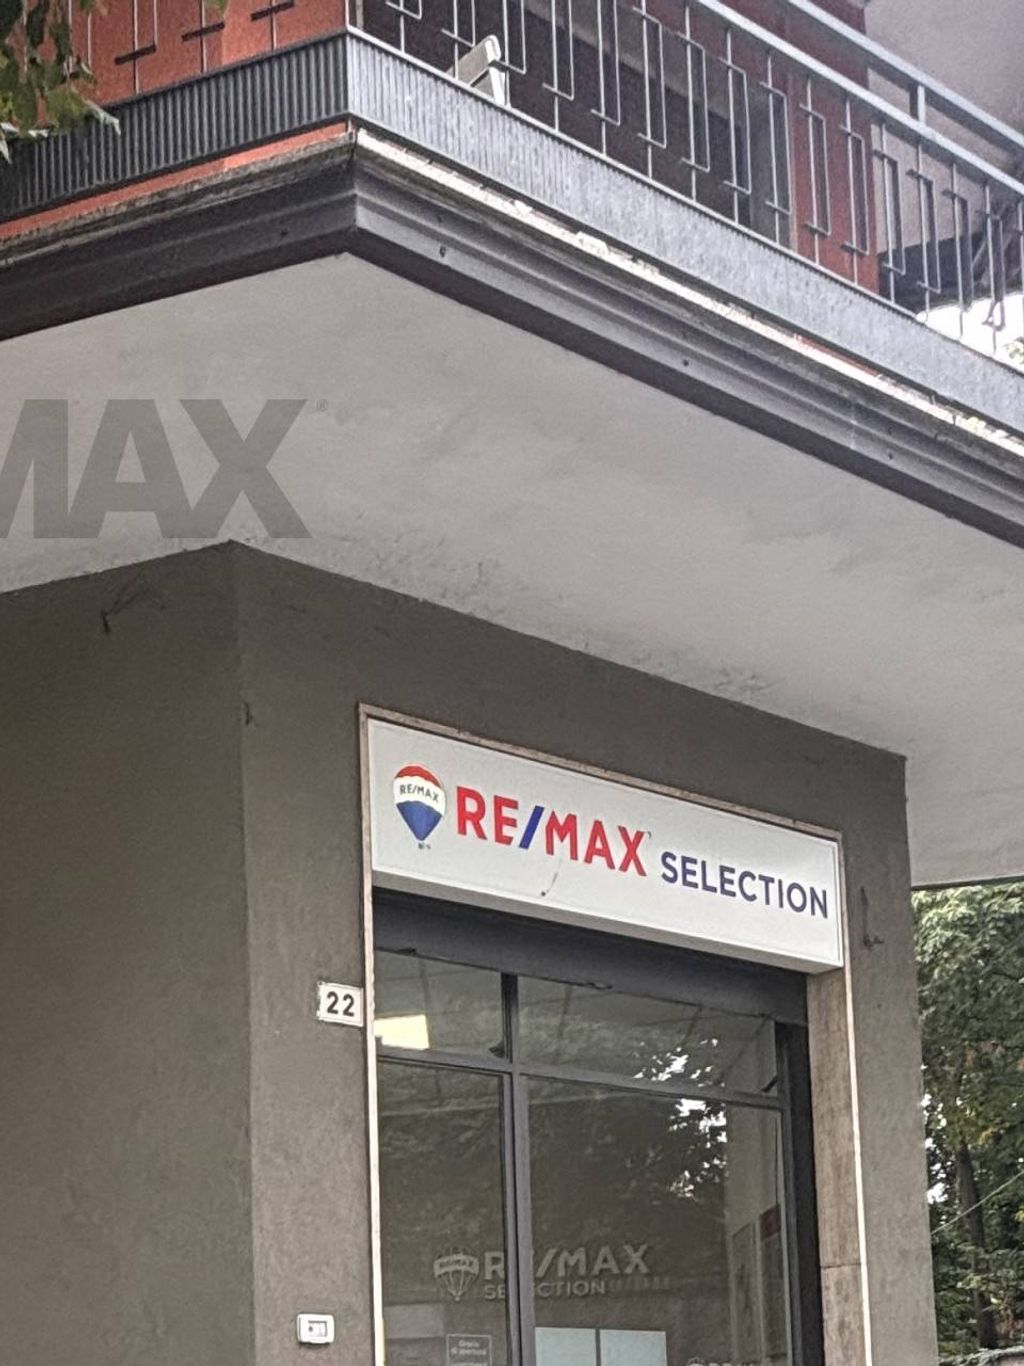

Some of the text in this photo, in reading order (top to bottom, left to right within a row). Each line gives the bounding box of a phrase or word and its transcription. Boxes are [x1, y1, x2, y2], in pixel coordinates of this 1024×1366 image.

[400, 784, 439, 803] RE/MAX
[456, 785, 829, 919] RE/MAX SELECTION
[326, 991, 355, 1017] 22
[484, 1244, 650, 1281] R/MAX
[484, 1278, 606, 1300] SECTION
